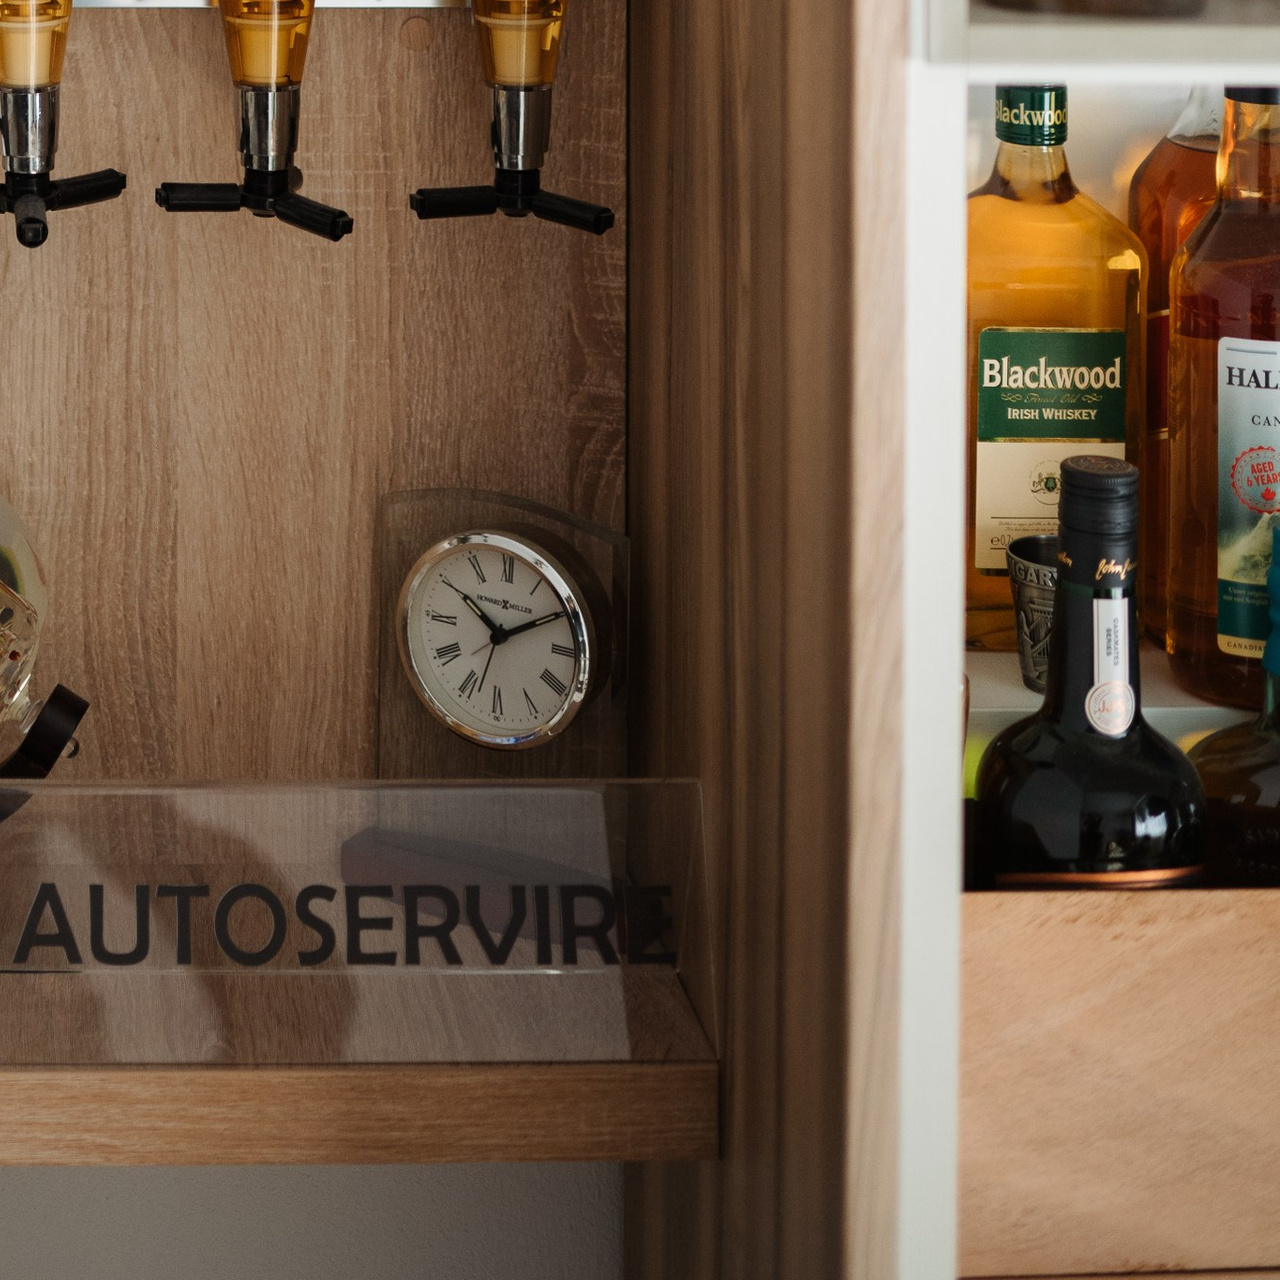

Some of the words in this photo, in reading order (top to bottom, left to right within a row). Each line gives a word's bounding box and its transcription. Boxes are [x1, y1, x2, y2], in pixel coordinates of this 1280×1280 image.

[983, 355, 1121, 390] Blackwood
[1008, 407, 1039, 420] IRISH
[1042, 408, 1098, 420] WHISKEY
[1250, 462, 1274, 474] AGED
[1246, 476, 1253, 487] 6
[477, 594, 502, 607] HOWARD
[509, 603, 532, 614] MILLER
[1227, 642, 1265, 652] CANADIA
[11, 881, 679, 966] AUTOSERVIRE
